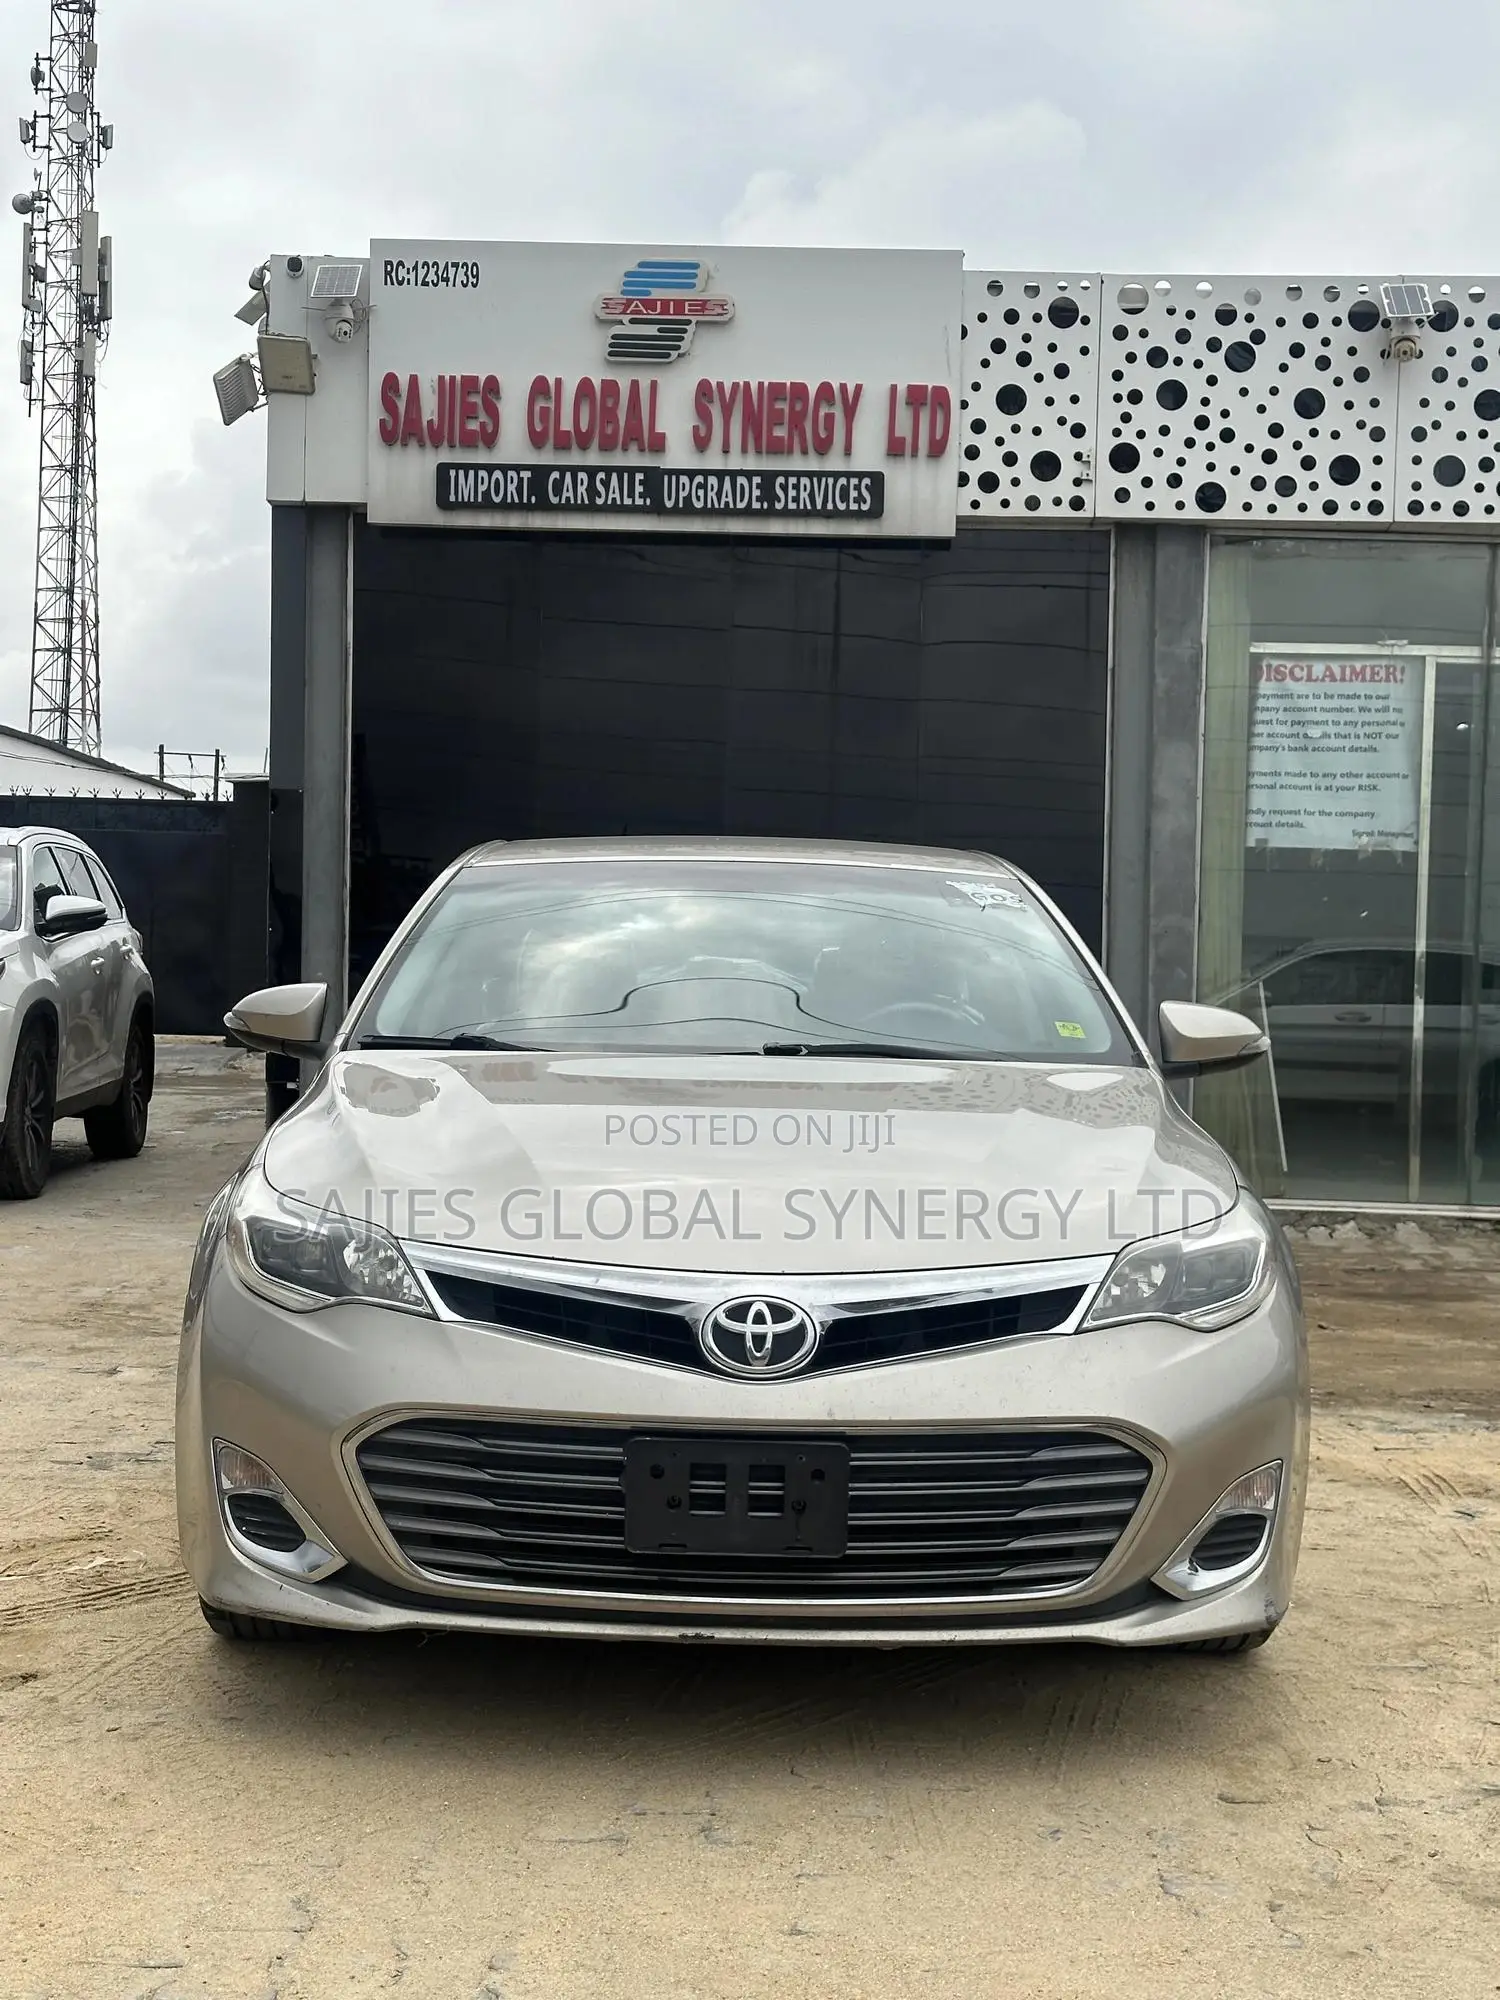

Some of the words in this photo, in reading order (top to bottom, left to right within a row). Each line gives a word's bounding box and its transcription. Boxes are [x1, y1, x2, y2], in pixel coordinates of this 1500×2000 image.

[383, 259, 480, 288] RC:1234739
[601, 299, 729, 315] SAJIES
[379, 371, 502, 447] SAJIES
[527, 375, 667, 452] GLOBAL
[692, 378, 864, 455] SYNERGY
[886, 384, 952, 458] LTD
[449, 469, 537, 504] IMPORT.
[547, 471, 588, 504] CAR
[595, 472, 651, 506] SALE.
[663, 474, 769, 509] UPGRADE.
[774, 475, 873, 511] SERVICES
[1312, 692, 1322, 700] to
[1324, 692, 1335, 700] be
[1337, 692, 1362, 700] made
[1275, 717, 1289, 725] for
[1290, 718, 1329, 727] payment
[1343, 720, 1359, 728] any
[1361, 719, 1398, 728] personal
[1288, 744, 1309, 752] bank
[1284, 770, 1307, 778] made
[1322, 772, 1338, 780] any
[1269, 808, 1302, 816] request
[1304, 808, 1317, 816] for
[1335, 811, 1376, 819] company
